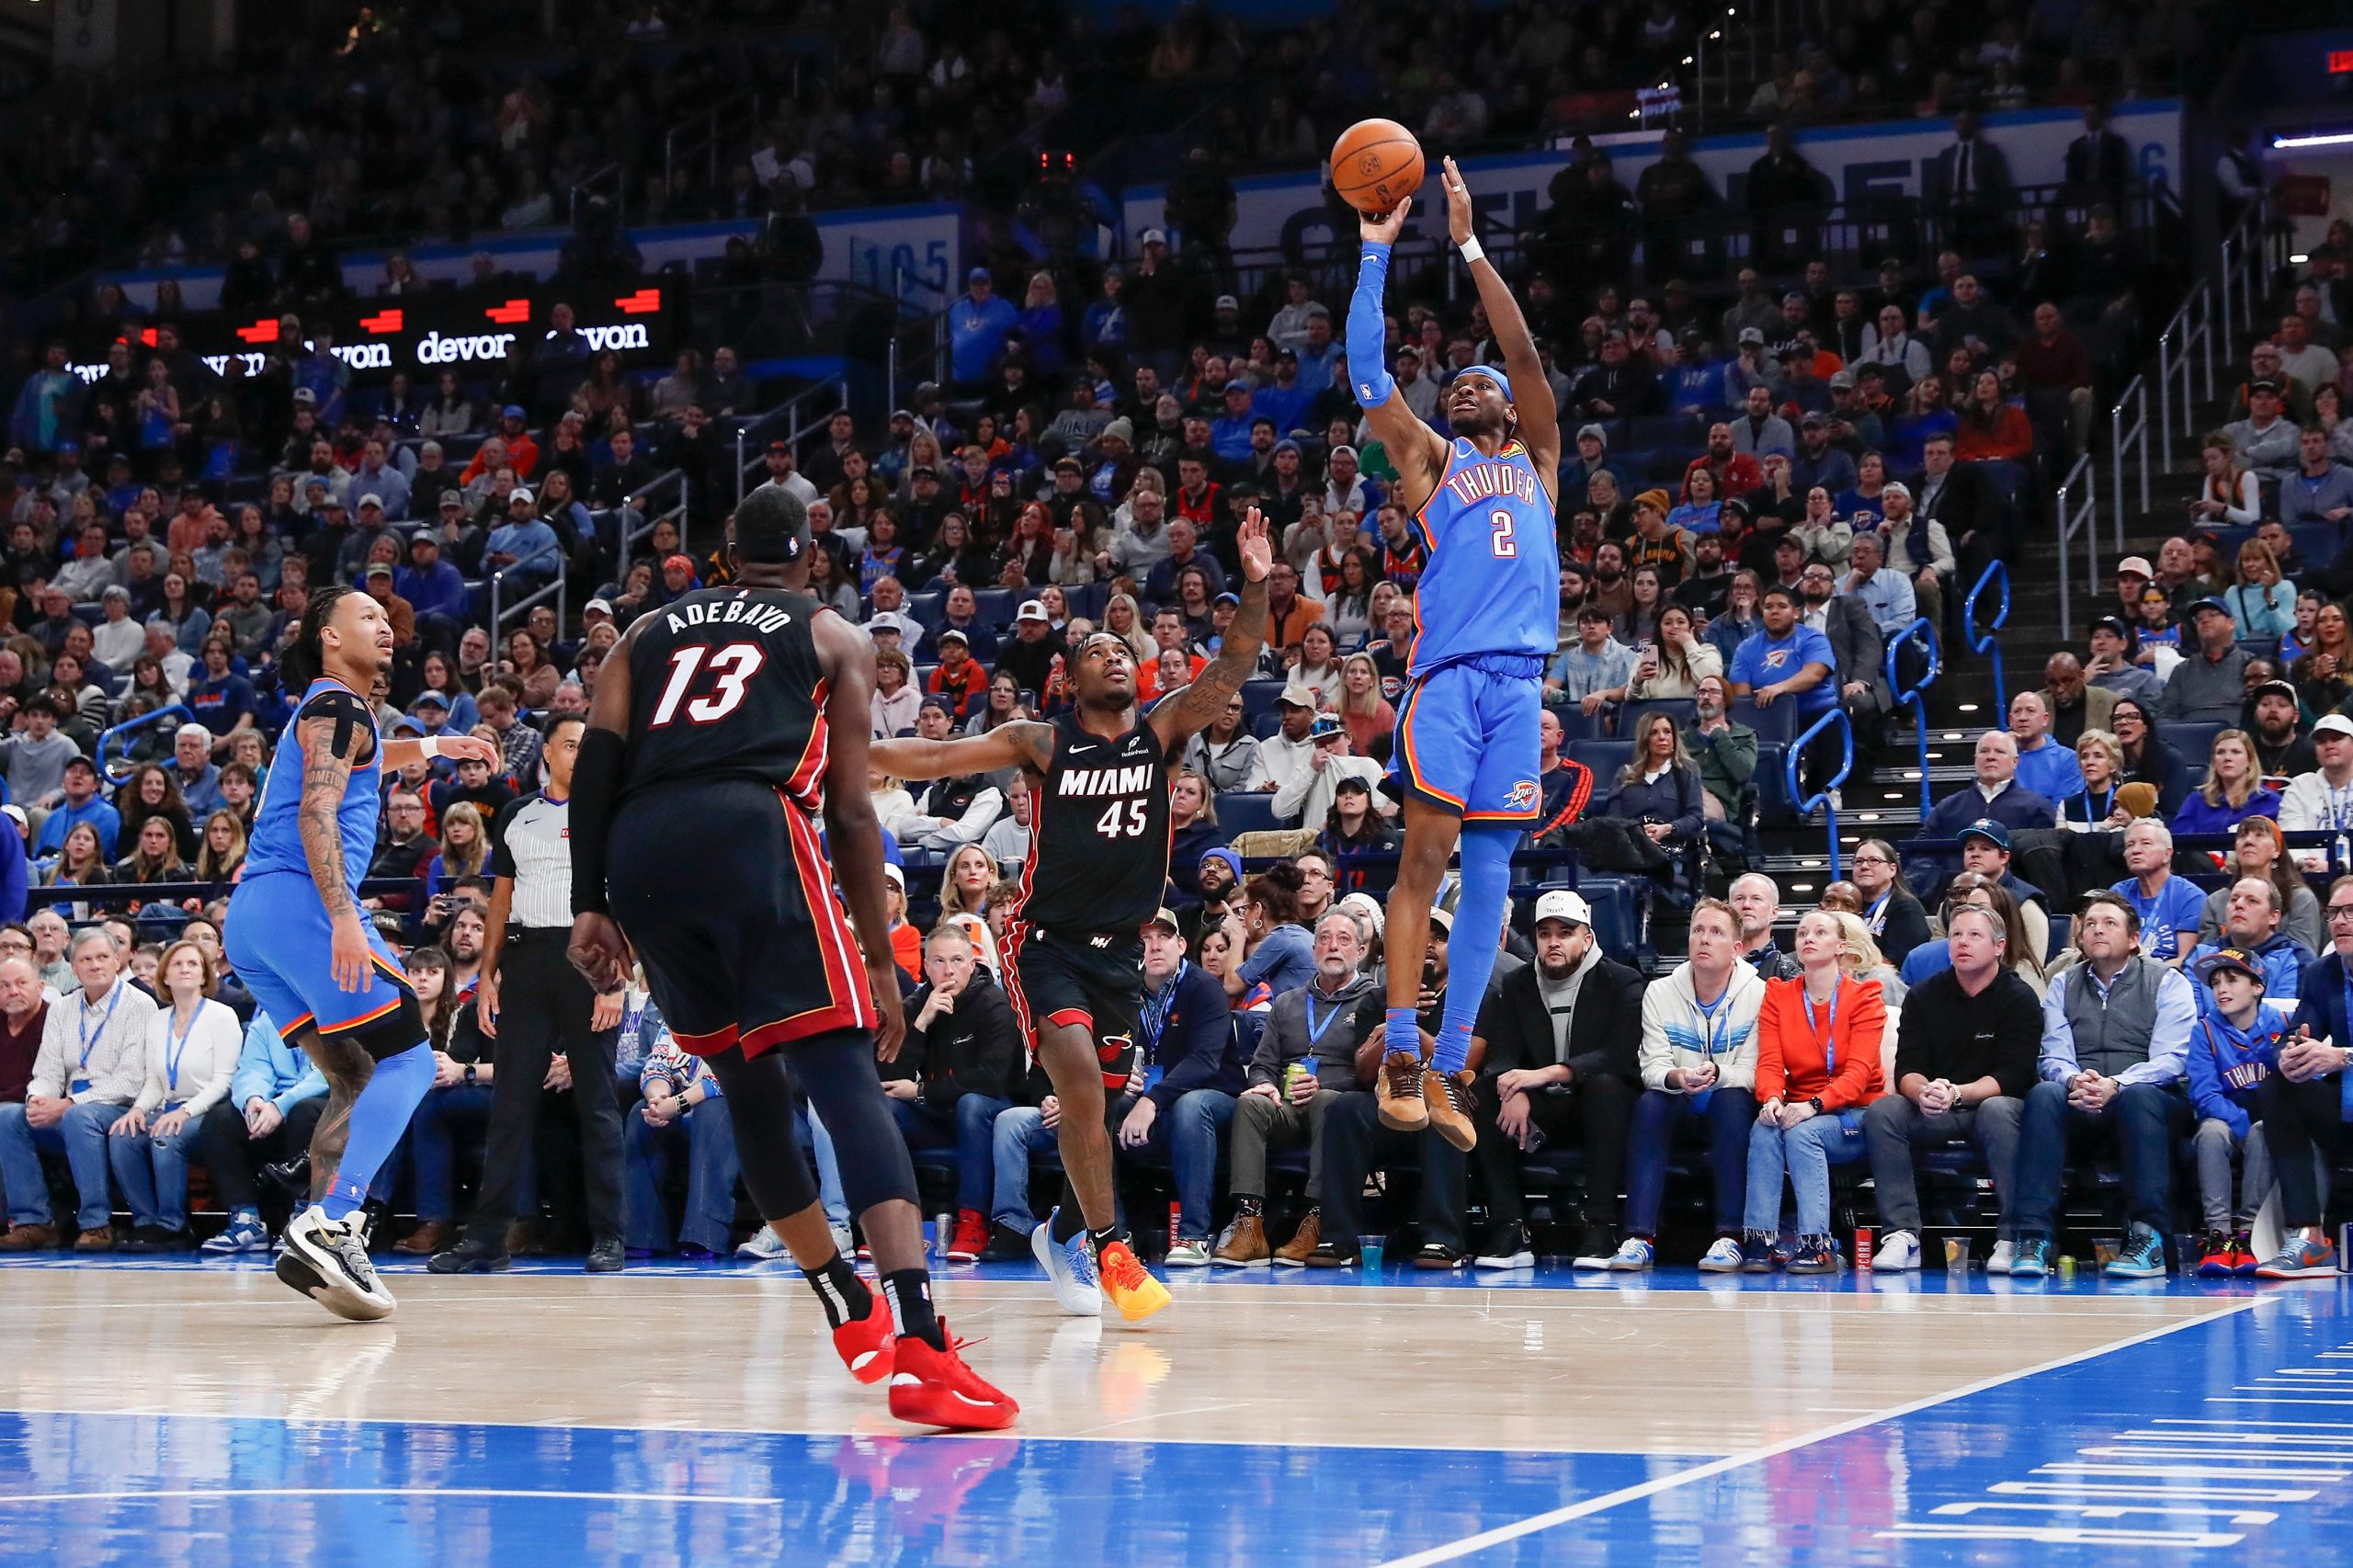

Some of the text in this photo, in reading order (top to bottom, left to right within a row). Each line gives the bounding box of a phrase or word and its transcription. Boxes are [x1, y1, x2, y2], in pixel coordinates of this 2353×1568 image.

[1447, 461, 1536, 506] THUNDER
[1491, 511, 1516, 557] 2
[666, 600, 791, 635] ADEBAYO
[650, 642, 765, 728] 13
[1121, 748, 1149, 758] Robinhood
[1059, 764, 1154, 797] MIAMI
[1513, 786, 1535, 801] OKC
[1097, 799, 1148, 838] 45
[2158, 924, 2175, 950] CITY
